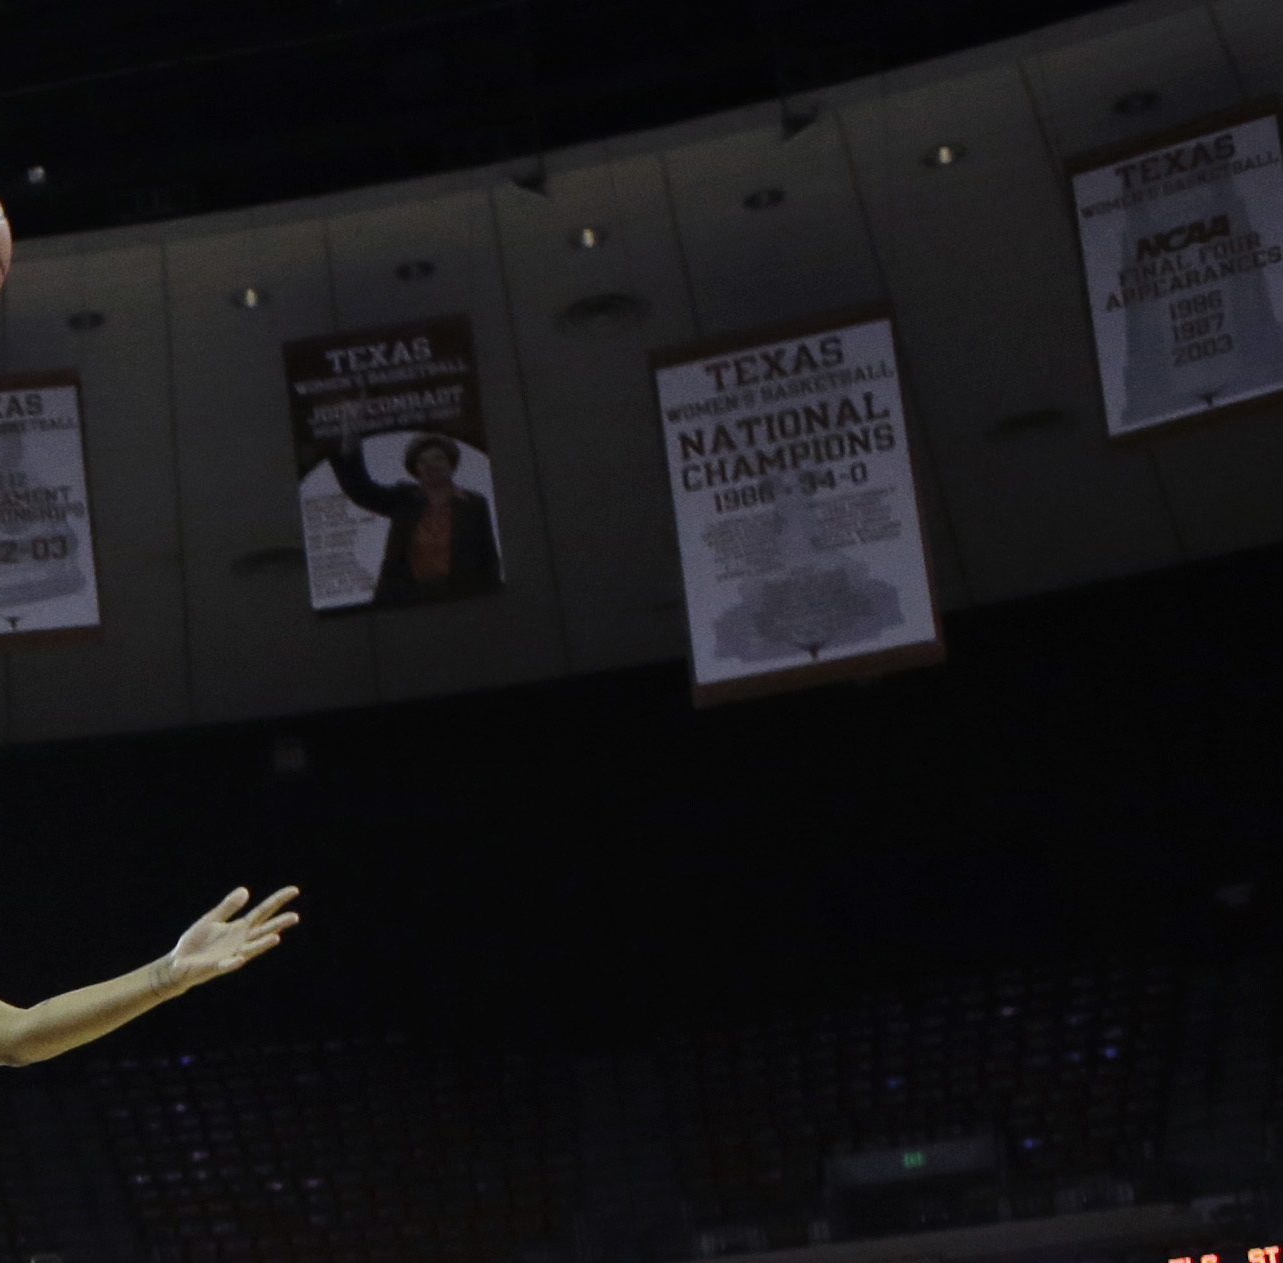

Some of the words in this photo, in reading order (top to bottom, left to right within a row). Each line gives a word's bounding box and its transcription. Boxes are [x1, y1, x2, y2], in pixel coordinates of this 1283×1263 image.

[1114, 133, 1235, 188] TEXAS
[1161, 151, 1279, 197] BASKETBALL
[1137, 215, 1230, 261] NCAA
[1119, 254, 1193, 287] FINAL
[325, 336, 432, 373] TEXAS
[705, 336, 844, 392] TEXAS
[760, 360, 896, 403] BASKETBALL
[678, 391, 891, 461] NATIONAL
[682, 422, 896, 492] CHAMPIONS
